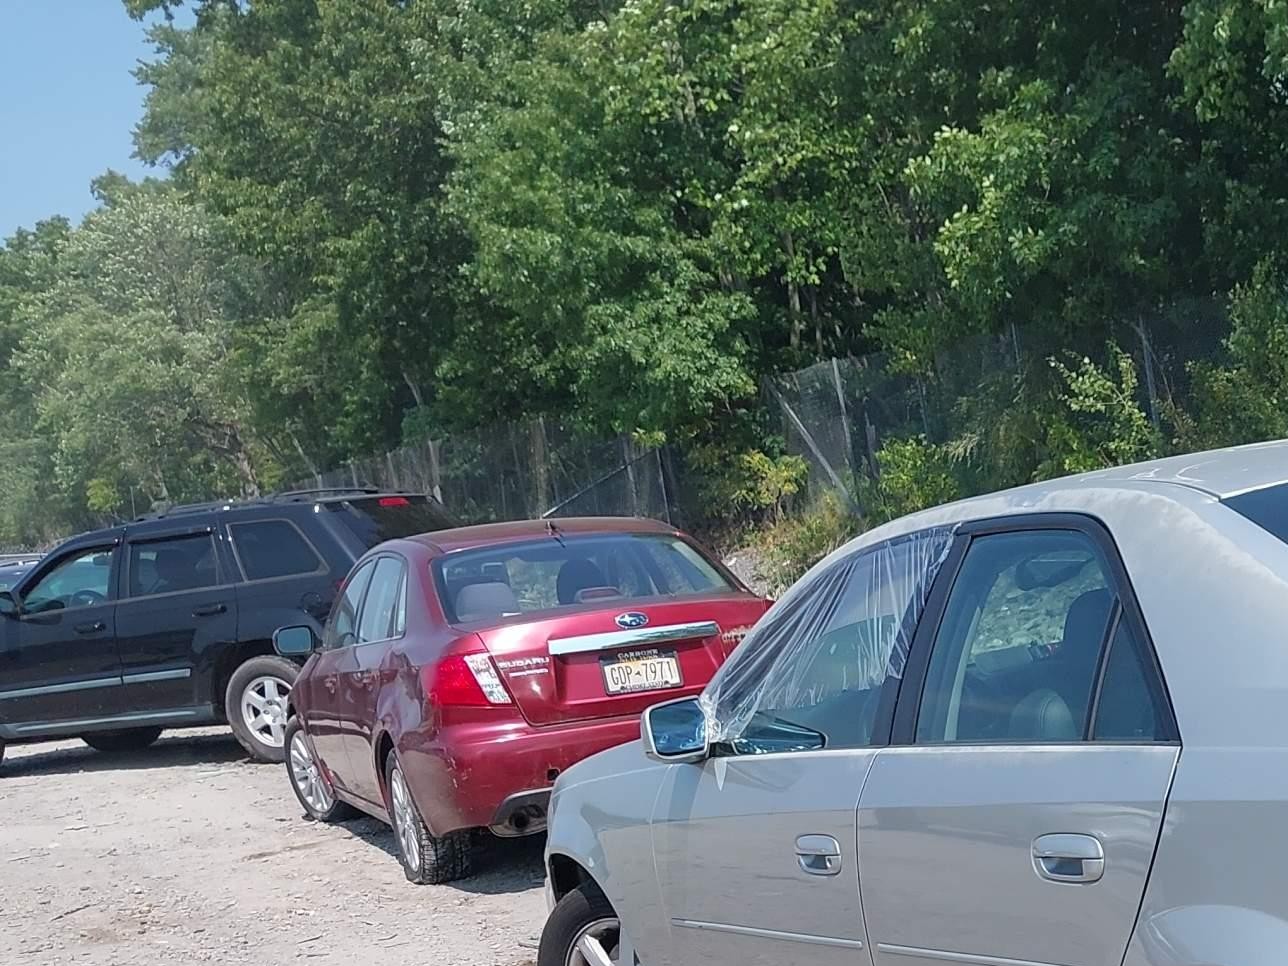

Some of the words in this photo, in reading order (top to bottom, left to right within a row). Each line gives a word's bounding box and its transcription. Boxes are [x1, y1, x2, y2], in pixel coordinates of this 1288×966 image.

[498, 656, 550, 669] SUBARU
[610, 665, 633, 686] GDP
[641, 660, 674, 682] 7971
